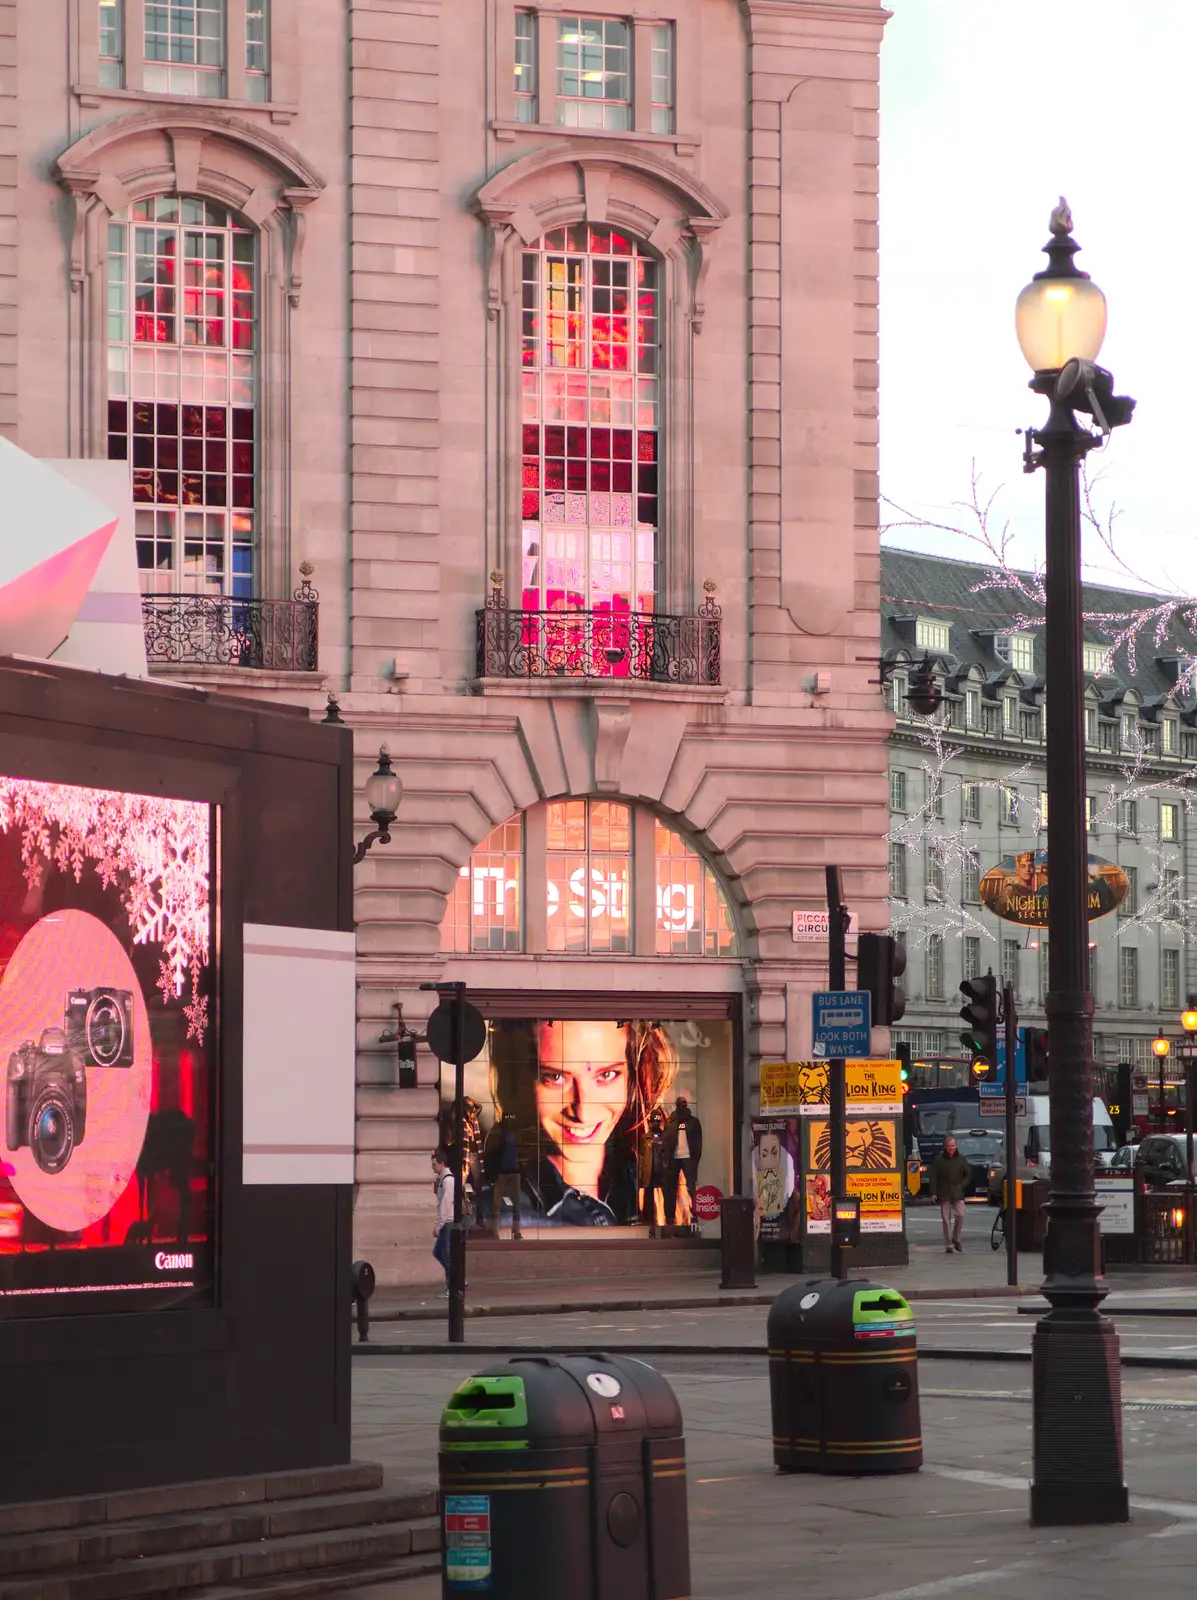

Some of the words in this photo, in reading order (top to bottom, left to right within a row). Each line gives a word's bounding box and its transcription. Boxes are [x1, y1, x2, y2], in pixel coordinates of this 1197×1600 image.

[569, 867, 695, 933] Stig
[1006, 894, 1042, 910] NIGHT
[1018, 911, 1048, 919] SECRE
[797, 924, 828, 932] CIRCU
[819, 996, 837, 1006] BUS
[840, 995, 864, 1005] LANE
[816, 1032, 840, 1041] LOOK
[843, 1031, 867, 1041] BOTH
[829, 1044, 854, 1054] WAYS
[845, 1082, 869, 1097] LION
[871, 1081, 897, 1097] KING
[1109, 1105, 1120, 1115] 23
[696, 1194, 715, 1203] Sale
[860, 1190, 879, 1202] LION
[880, 1190, 900, 1202] KING
[696, 1202, 721, 1212] Inside
[155, 1252, 194, 1270] Canon
